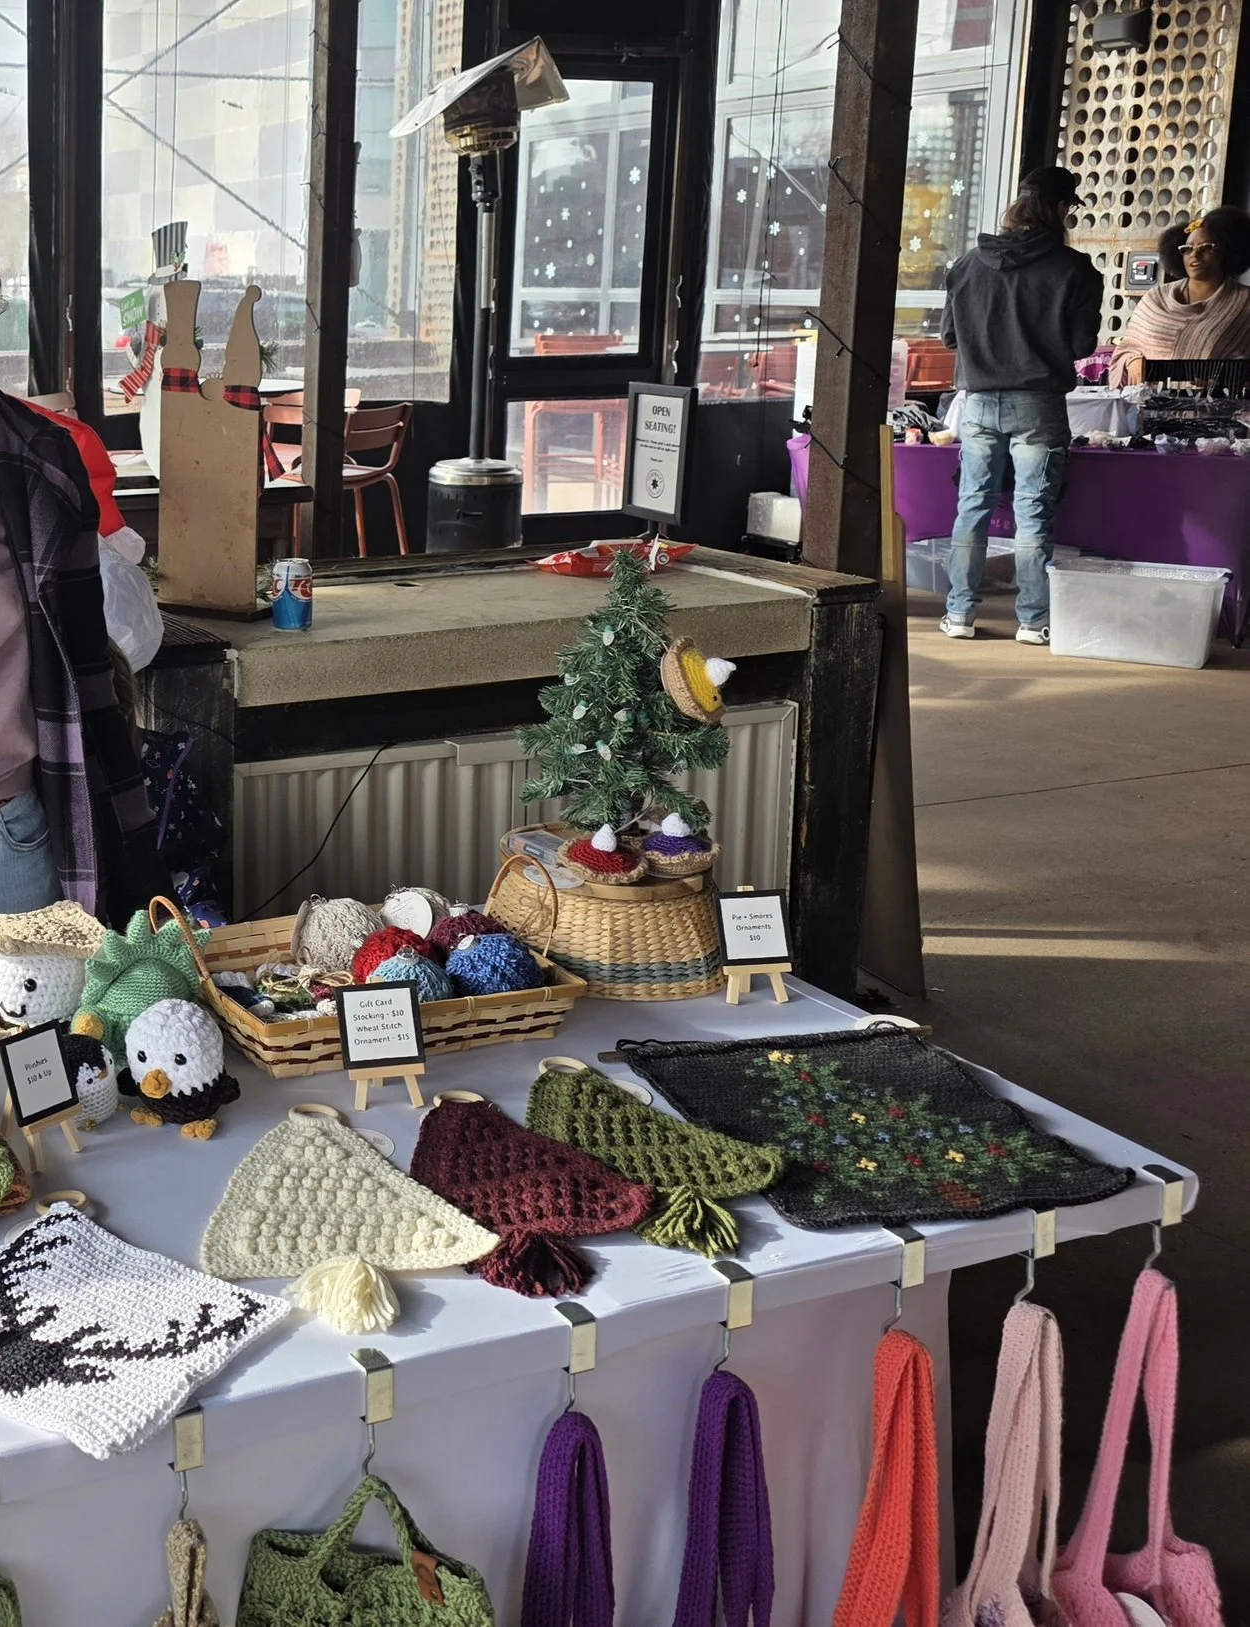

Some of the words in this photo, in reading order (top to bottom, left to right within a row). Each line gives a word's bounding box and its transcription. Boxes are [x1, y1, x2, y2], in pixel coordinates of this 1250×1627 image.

[652, 405, 670, 416] OPEN
[644, 420, 676, 434] SEATING!
[353, 1012, 384, 1021] Stocking
[382, 1022, 403, 1030] Stitch
[354, 1037, 390, 1046] Ornament
[24, 1058, 48, 1071] Plushies
[27, 1074, 37, 1084] $10
[43, 1069, 52, 1077] Up
